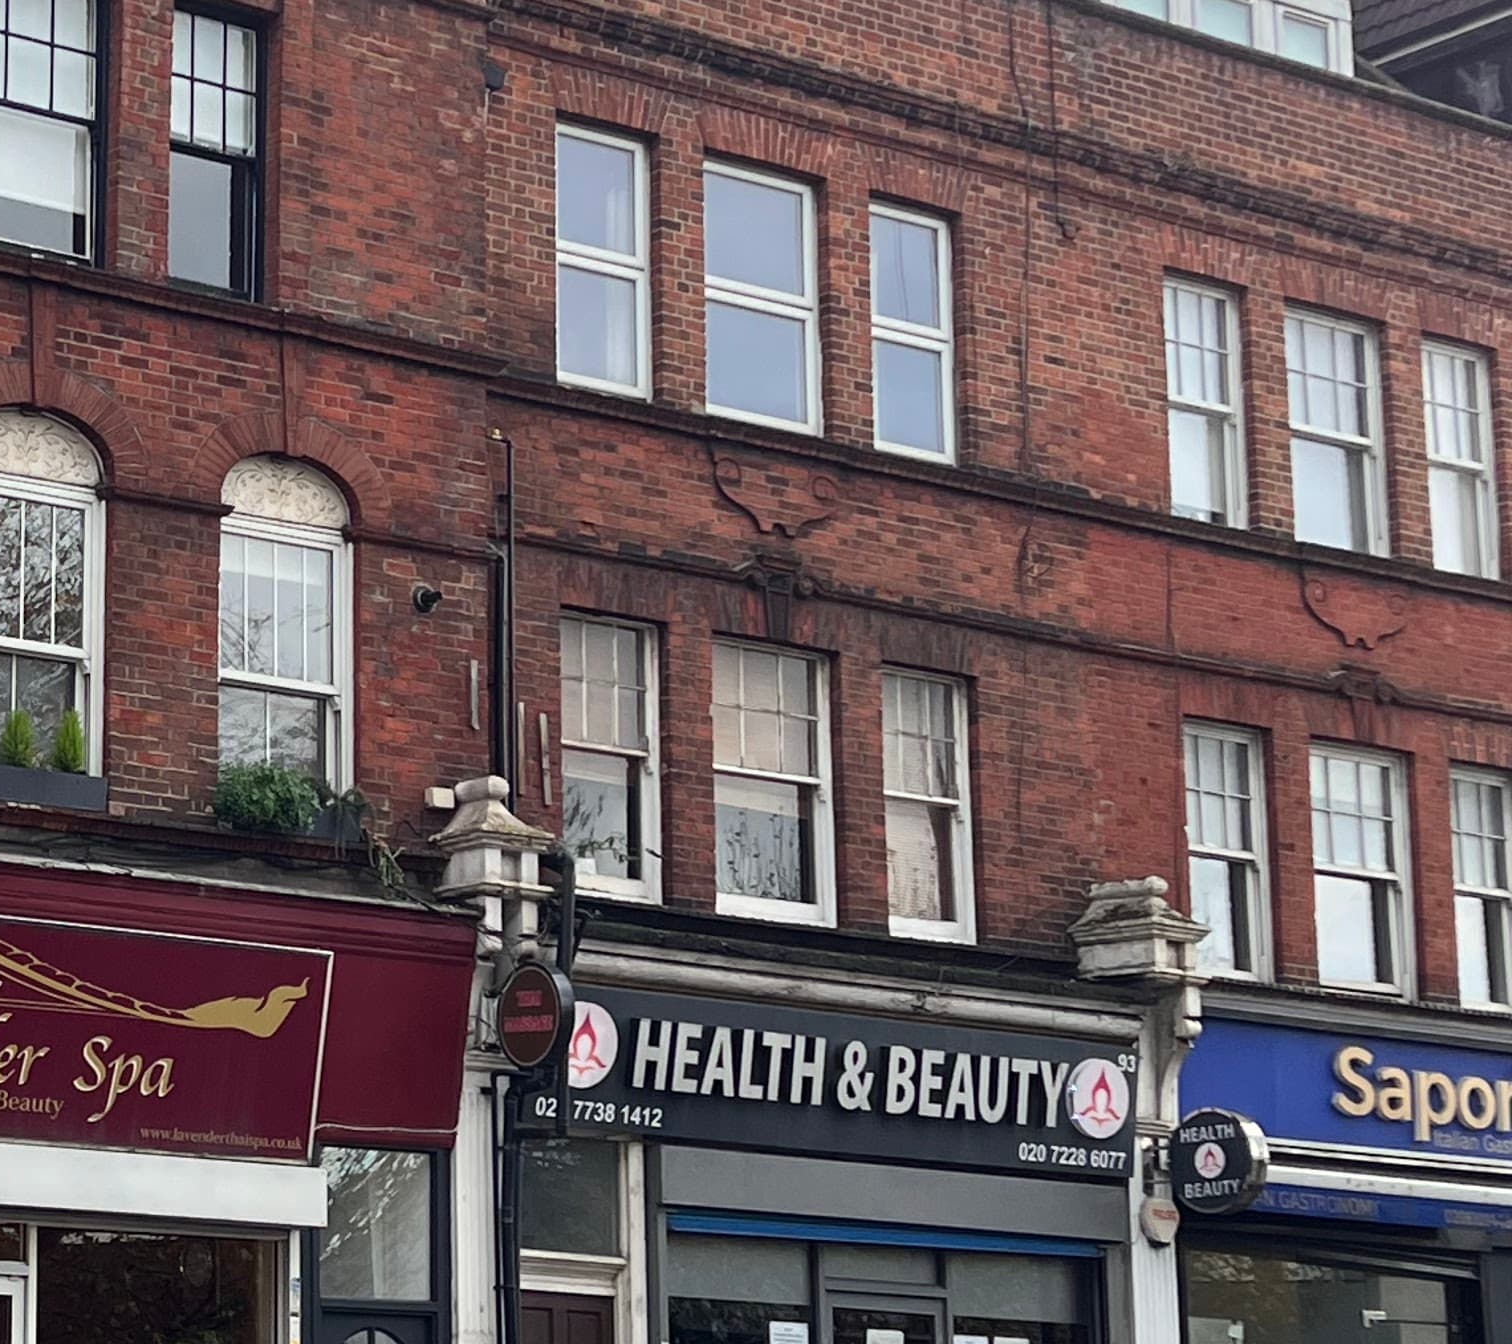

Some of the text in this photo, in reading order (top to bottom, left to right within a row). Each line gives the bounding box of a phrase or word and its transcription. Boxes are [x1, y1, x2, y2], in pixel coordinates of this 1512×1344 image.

[631, 1018, 1070, 1128] HEALTH & BEAUTY
[1118, 1054, 1137, 1073] 93
[74, 1035, 175, 1123] Spa
[535, 1096, 663, 1128] 02 7738 1412
[1179, 1123, 1235, 1143] HEALTH
[1018, 1142, 1127, 1169] 020 7228 6077
[1184, 1178, 1240, 1199] BEAUTY
